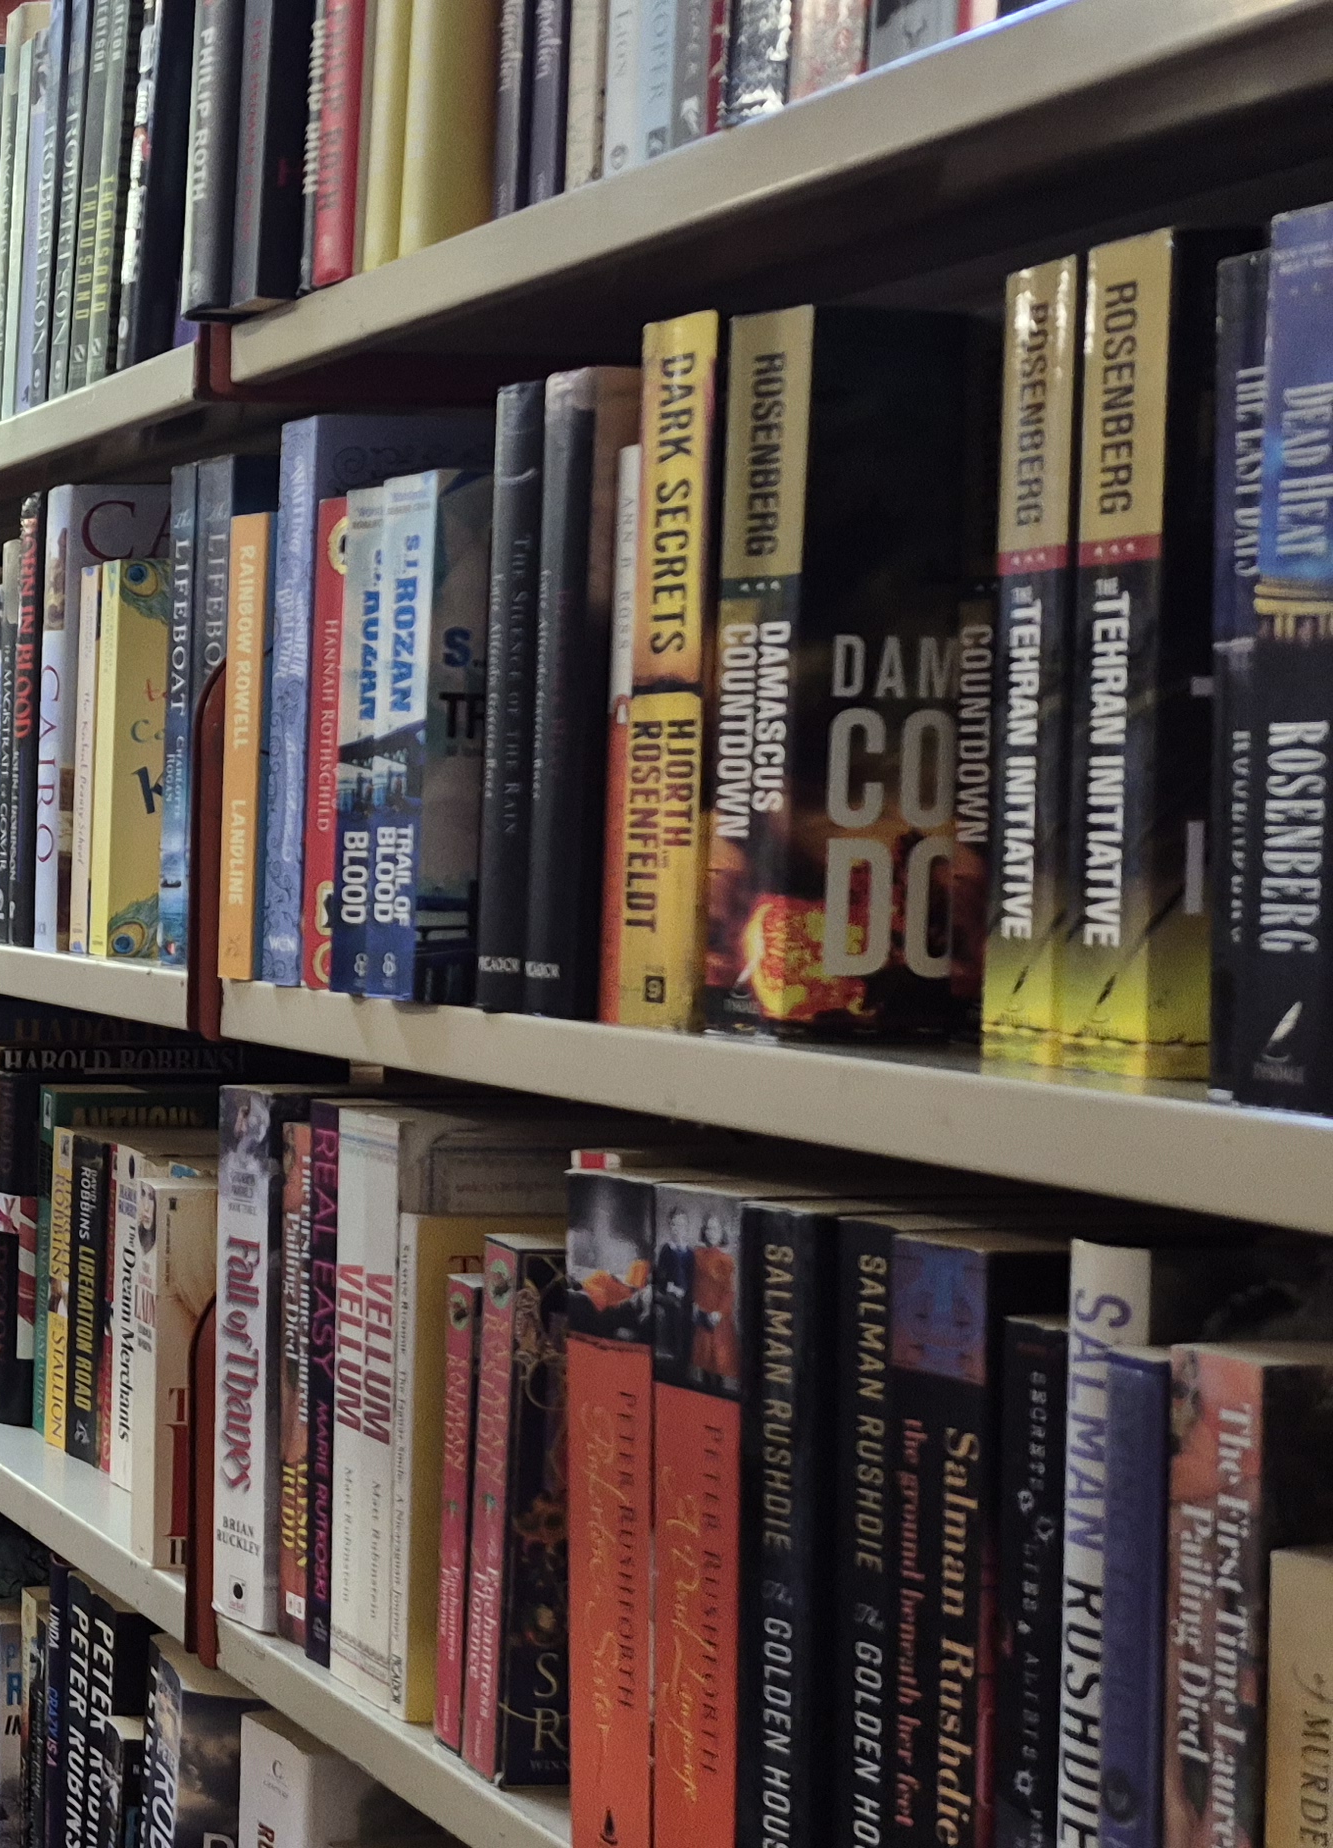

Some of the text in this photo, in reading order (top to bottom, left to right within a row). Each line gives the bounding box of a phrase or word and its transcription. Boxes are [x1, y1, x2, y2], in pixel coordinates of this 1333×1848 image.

[192, 27, 216, 201] PHILIP ROTH
[53, 114, 79, 356] ROBERTSON
[75, 183, 99, 322] THOUSAND
[92, 175, 114, 313] THOUSAND
[744, 350, 786, 560] ROSENBERG
[1016, 303, 1050, 528] ROSENBERG
[1099, 280, 1139, 518] ROSENBERG
[1276, 381, 1333, 558] DEAD HEAT
[652, 350, 695, 659] DARK SECRETS
[170, 539, 191, 719] LIFEBOAT
[227, 545, 255, 907] RAINBOW ROWELL LANDLINE
[316, 619, 340, 833] HANNAH ROTHSCHILD
[389, 575, 419, 713] ROZAN
[38, 663, 61, 865] CAIRO
[622, 717, 694, 934] HJORTH ROSENFELDT
[716, 620, 792, 840] DAMASCUS COUNTDOWN
[955, 623, 993, 843] COUNTDOWN
[1000, 599, 1044, 941] TEHRAN INITIATIVE
[1083, 591, 1132, 950] TEHRAN INITIATIVE
[340, 830, 370, 926] BLOOD
[374, 825, 397, 925] BLOOD
[393, 823, 415, 930] TRAIL OF
[1262, 720, 1328, 954] ROSENBERG
[74, 1164, 96, 1413] ROBBINS LIBERATION ROAD
[117, 1246, 137, 1443] Dream Merchants
[284, 1304, 299, 1361] Died
[312, 1120, 339, 1384] REAL EASY
[336, 1263, 365, 1435] VELLUM
[856, 1252, 887, 1400] SALMAN
[49, 1327, 66, 1441] STALLION
[221, 1235, 261, 1497] Fall of Thanes
[362, 1272, 393, 1447] VELLUM
[215, 1514, 261, 1559] BRIAN RUCKLEY
[762, 1244, 794, 1756] SALMAN RUSHDIE GOLDEN
[854, 1414, 886, 1573] RUSHDIE
[1062, 1291, 1132, 1848] SALMAN RUSHDIE
[1213, 1401, 1252, 1718] The First Time
[48, 1603, 61, 1650] LINDA
[68, 1603, 90, 1719] PETER
[89, 1618, 114, 1735] PETER
[853, 1640, 884, 1804] GOLDEN
[897, 1568, 925, 1684] beneath
[936, 1425, 979, 1847] Salman Rushdie
[1171, 1502, 1212, 1763] Pailing Died
